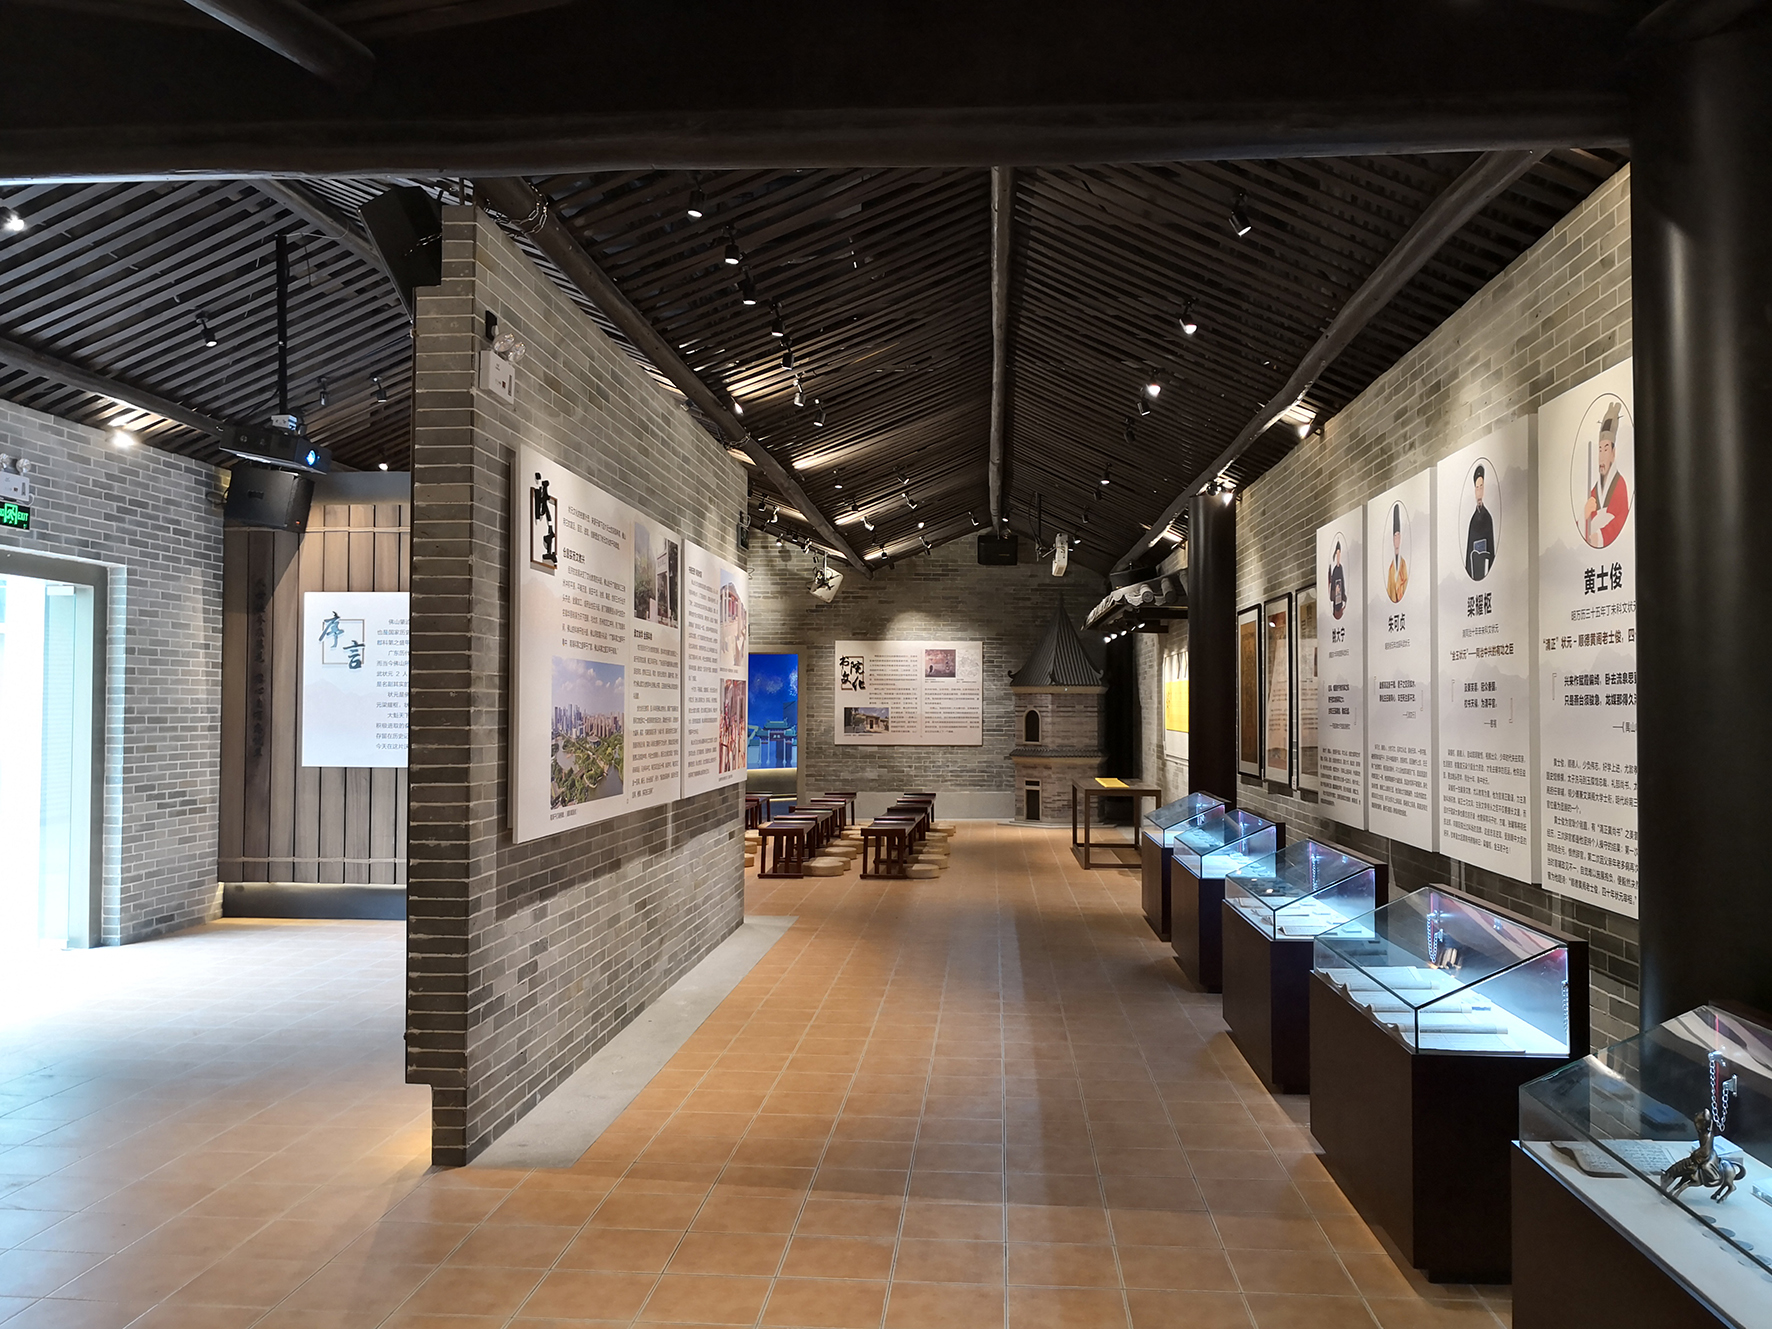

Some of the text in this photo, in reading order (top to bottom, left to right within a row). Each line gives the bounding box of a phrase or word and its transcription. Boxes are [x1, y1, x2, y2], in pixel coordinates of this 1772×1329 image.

[18, 511, 29, 521] EXIT
[1584, 562, 1623, 595] 黄士俊
[1467, 592, 1492, 617] 梁耀枢
[1388, 613, 1405, 633] 朱可贞
[318, 611, 366, 669] 序言
